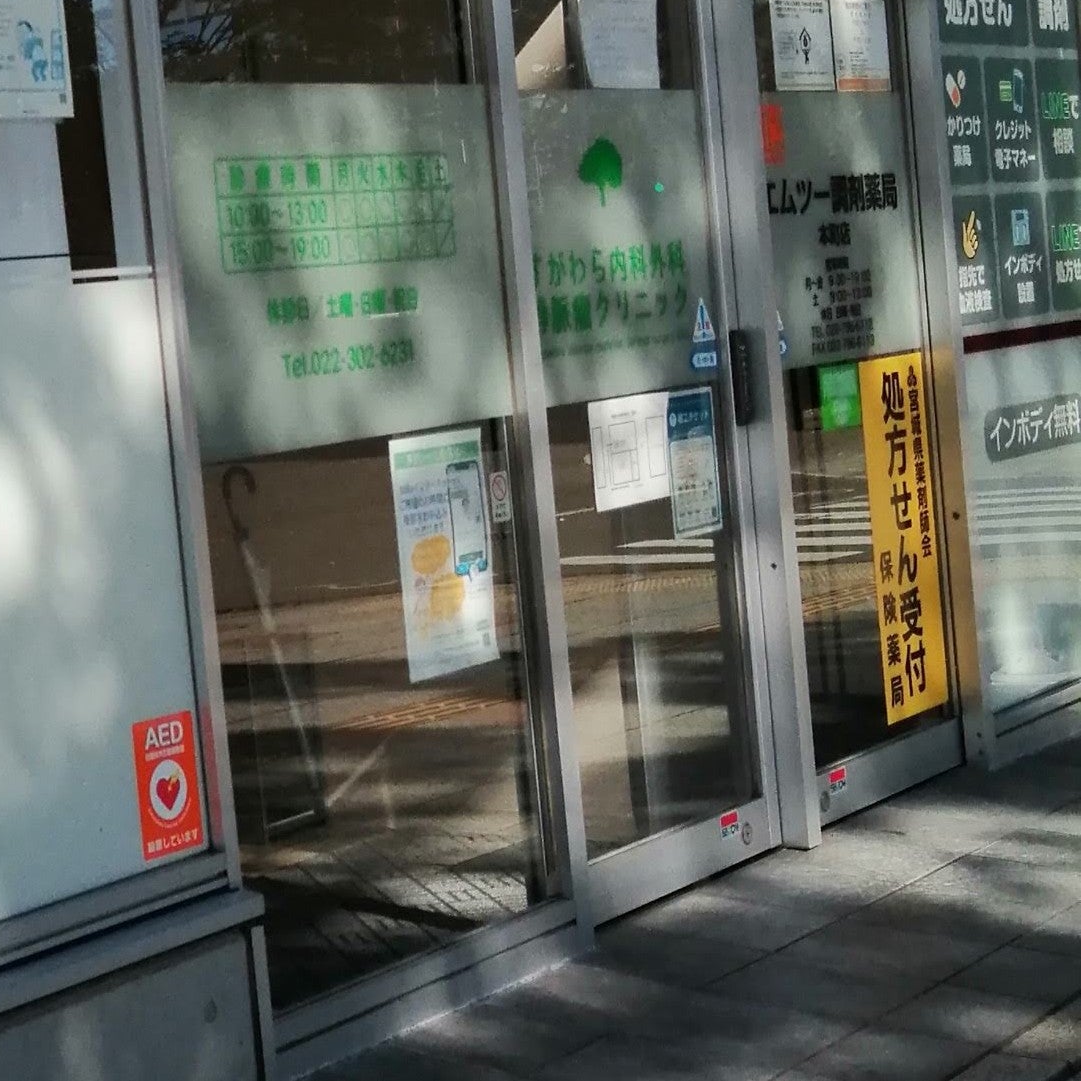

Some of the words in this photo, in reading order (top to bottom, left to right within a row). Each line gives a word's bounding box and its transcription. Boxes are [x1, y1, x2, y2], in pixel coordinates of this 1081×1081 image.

[995, 120, 1032, 140] クレジット
[880, 370, 927, 698] 処方せん受付
[879, 550, 905, 708] 保険薬局
[145, 720, 184, 751] AED
